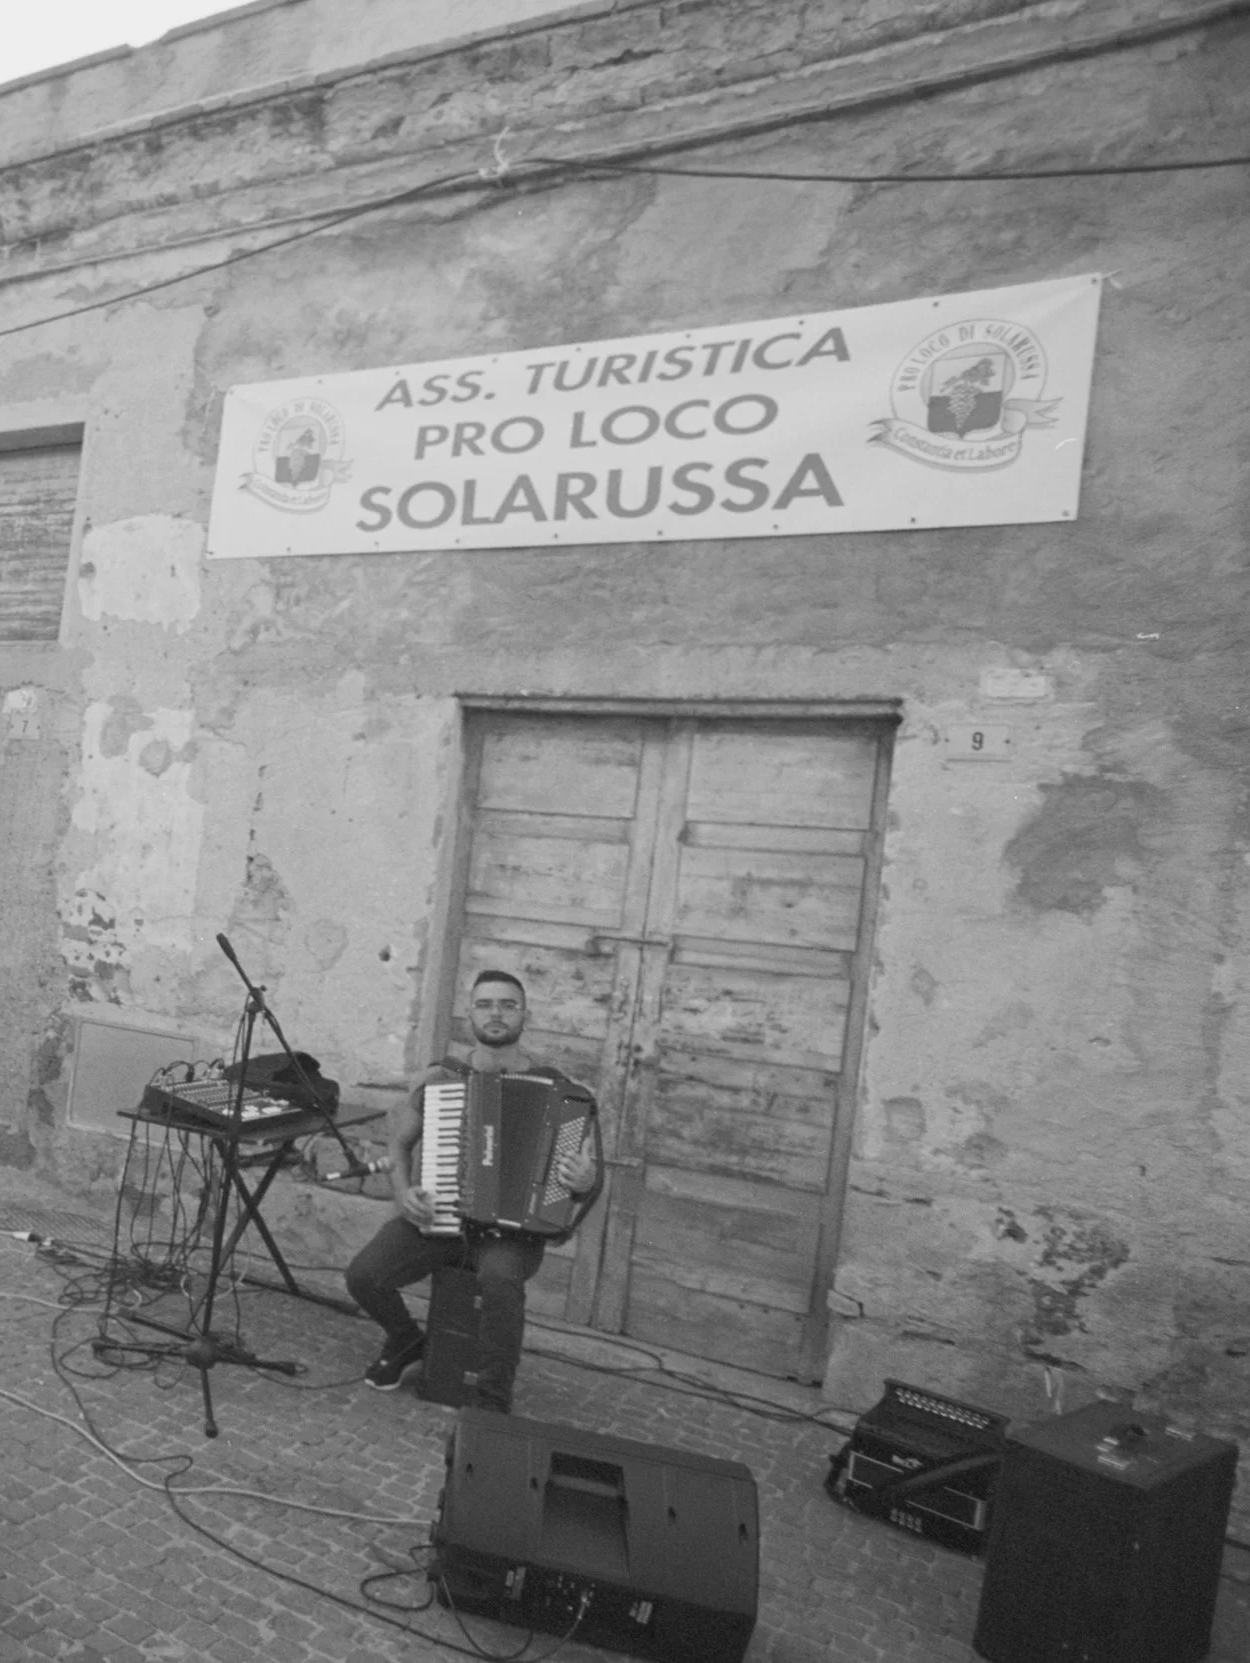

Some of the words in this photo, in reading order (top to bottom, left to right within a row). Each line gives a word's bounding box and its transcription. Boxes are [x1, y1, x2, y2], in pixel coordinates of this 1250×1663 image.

[958, 324, 975, 343] DI
[374, 369, 496, 412] ASS.
[526, 326, 852, 396] TURISTICA
[414, 416, 545, 461] PRO
[569, 393, 779, 449] LOCO
[355, 452, 845, 532] SOLARUSSA
[972, 731, 985, 752] 9
